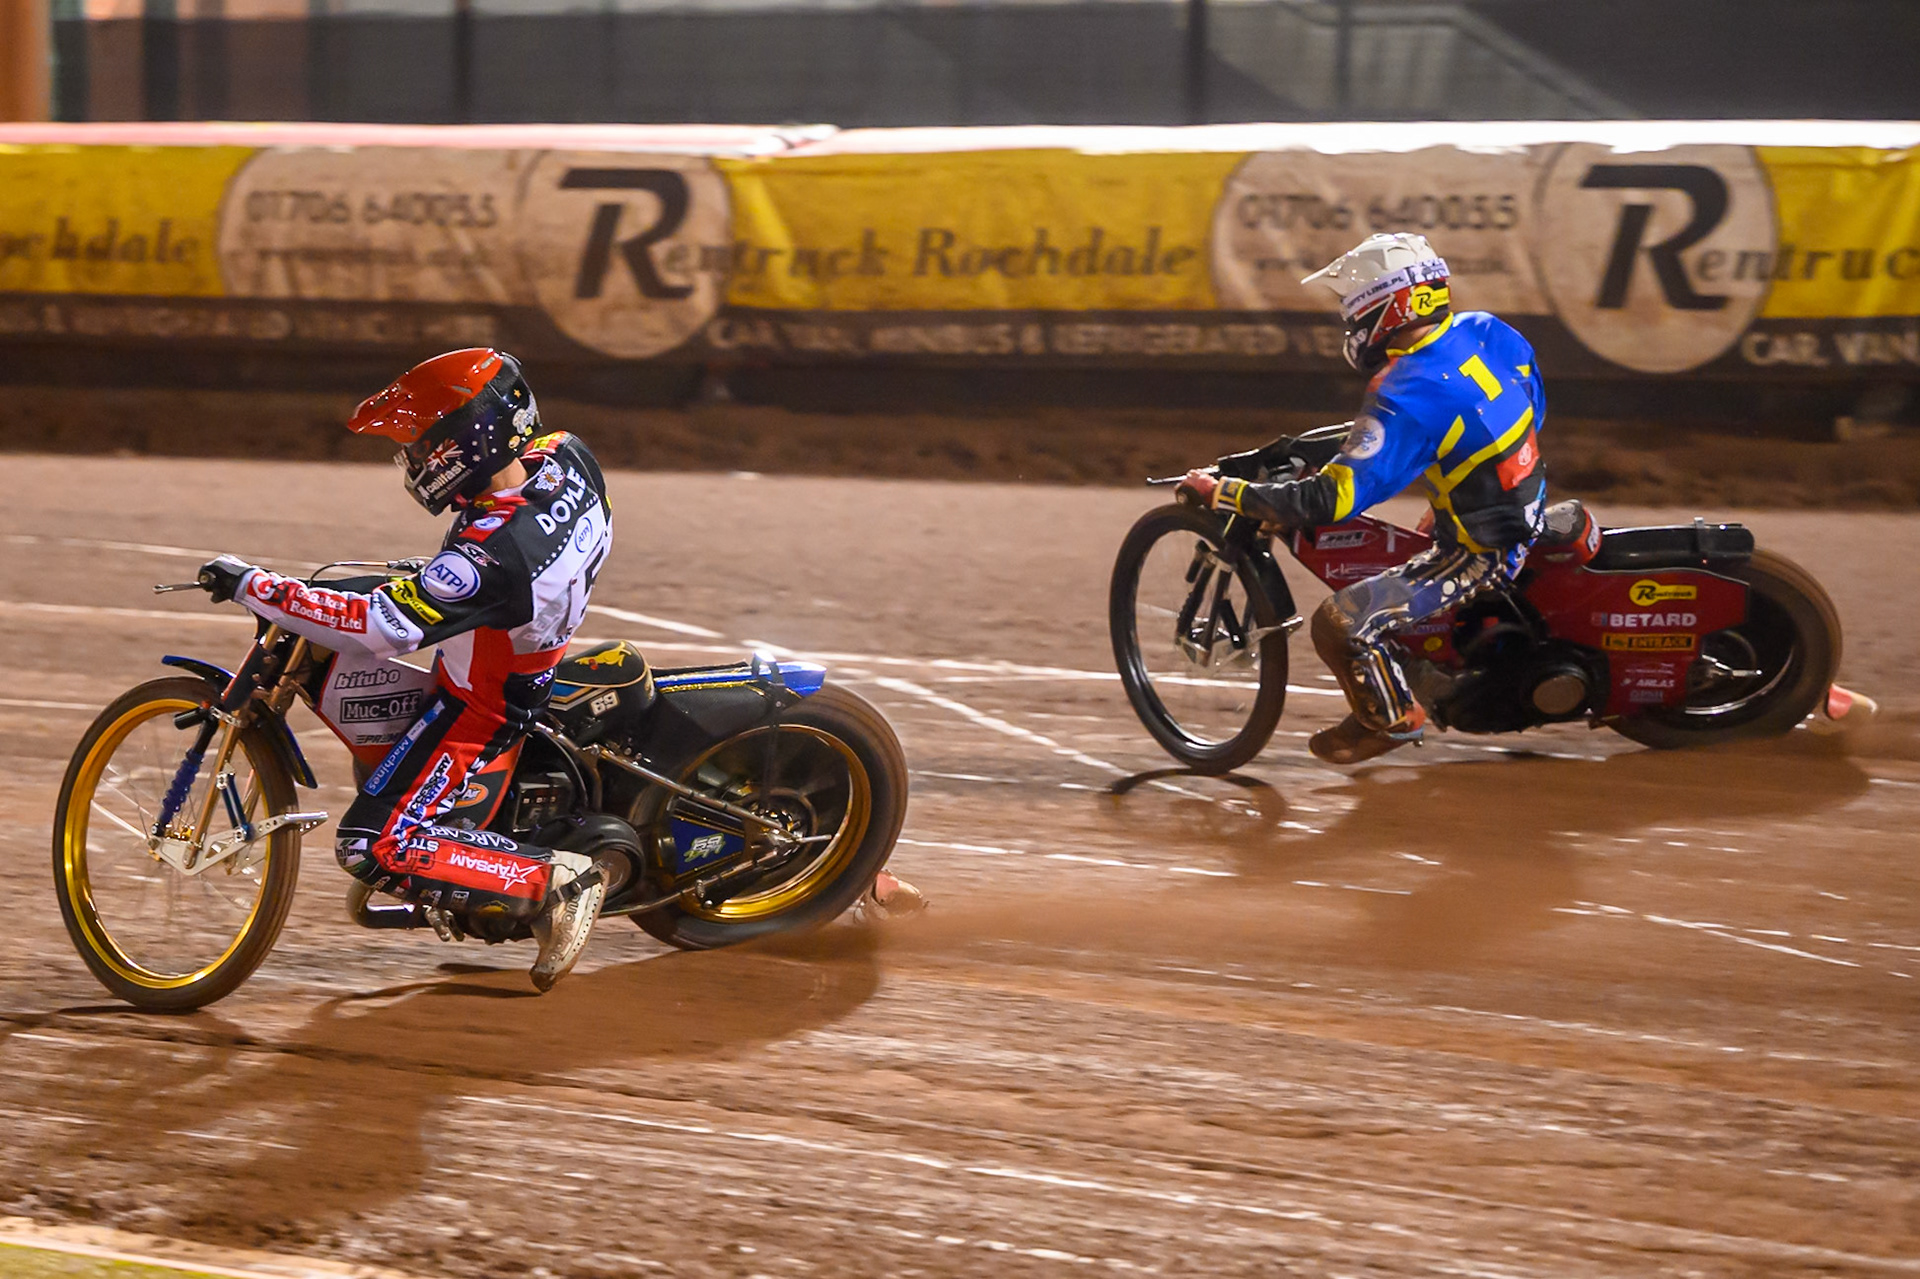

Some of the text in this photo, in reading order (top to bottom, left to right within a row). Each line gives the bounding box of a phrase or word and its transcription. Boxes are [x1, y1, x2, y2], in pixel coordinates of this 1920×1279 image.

[912, 226, 1199, 280] Rochdale
[1458, 354, 1503, 401] 1
[534, 466, 587, 536] DOYLE
[429, 562, 467, 593] ATPI
[289, 601, 363, 631] Roofing Ltd
[1610, 613, 1697, 627] BETARD
[334, 668, 400, 690] bitubo
[346, 695, 419, 719] Muc-Off
[367, 738, 411, 790] Machines
